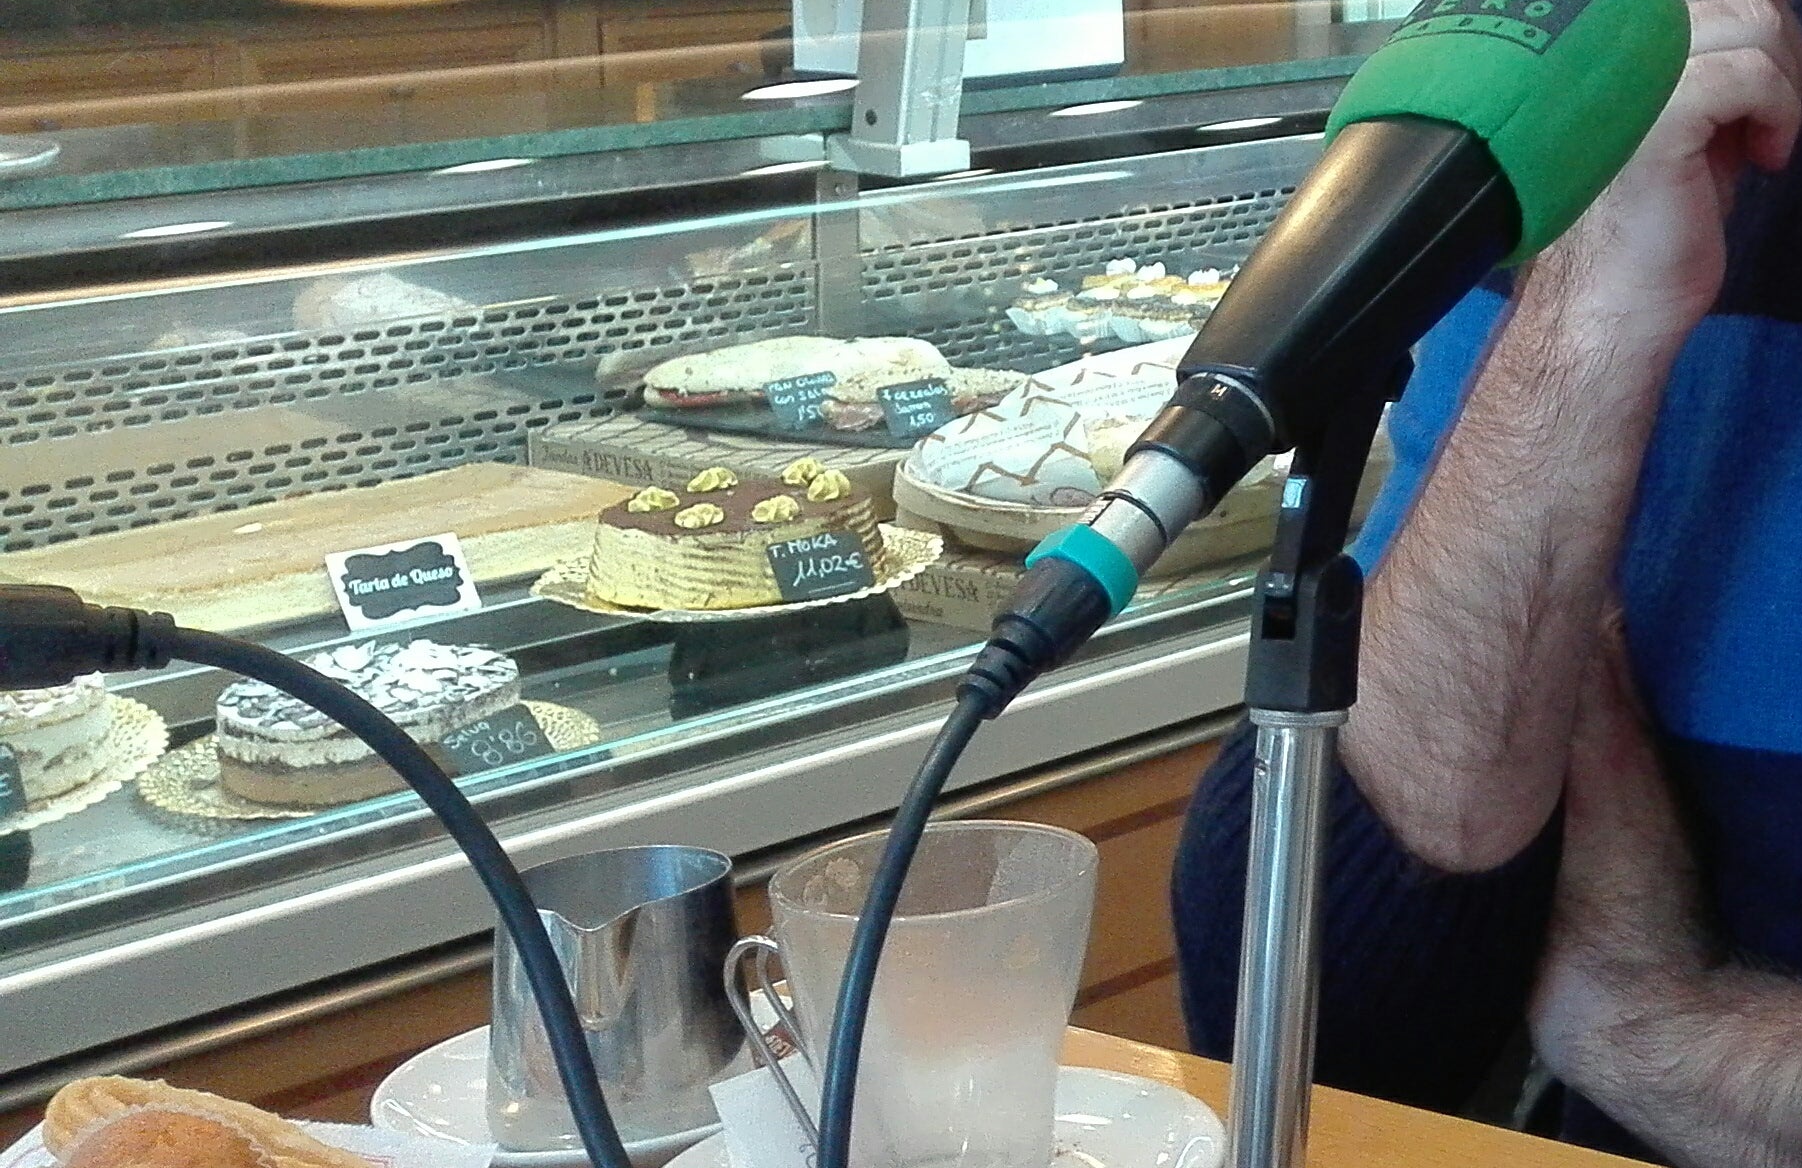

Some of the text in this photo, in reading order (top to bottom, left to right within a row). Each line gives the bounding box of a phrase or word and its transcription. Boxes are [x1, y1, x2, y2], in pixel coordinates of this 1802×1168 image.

[768, 533, 838, 559] T. MOKA
[348, 566, 454, 596] Tarta de Queso
